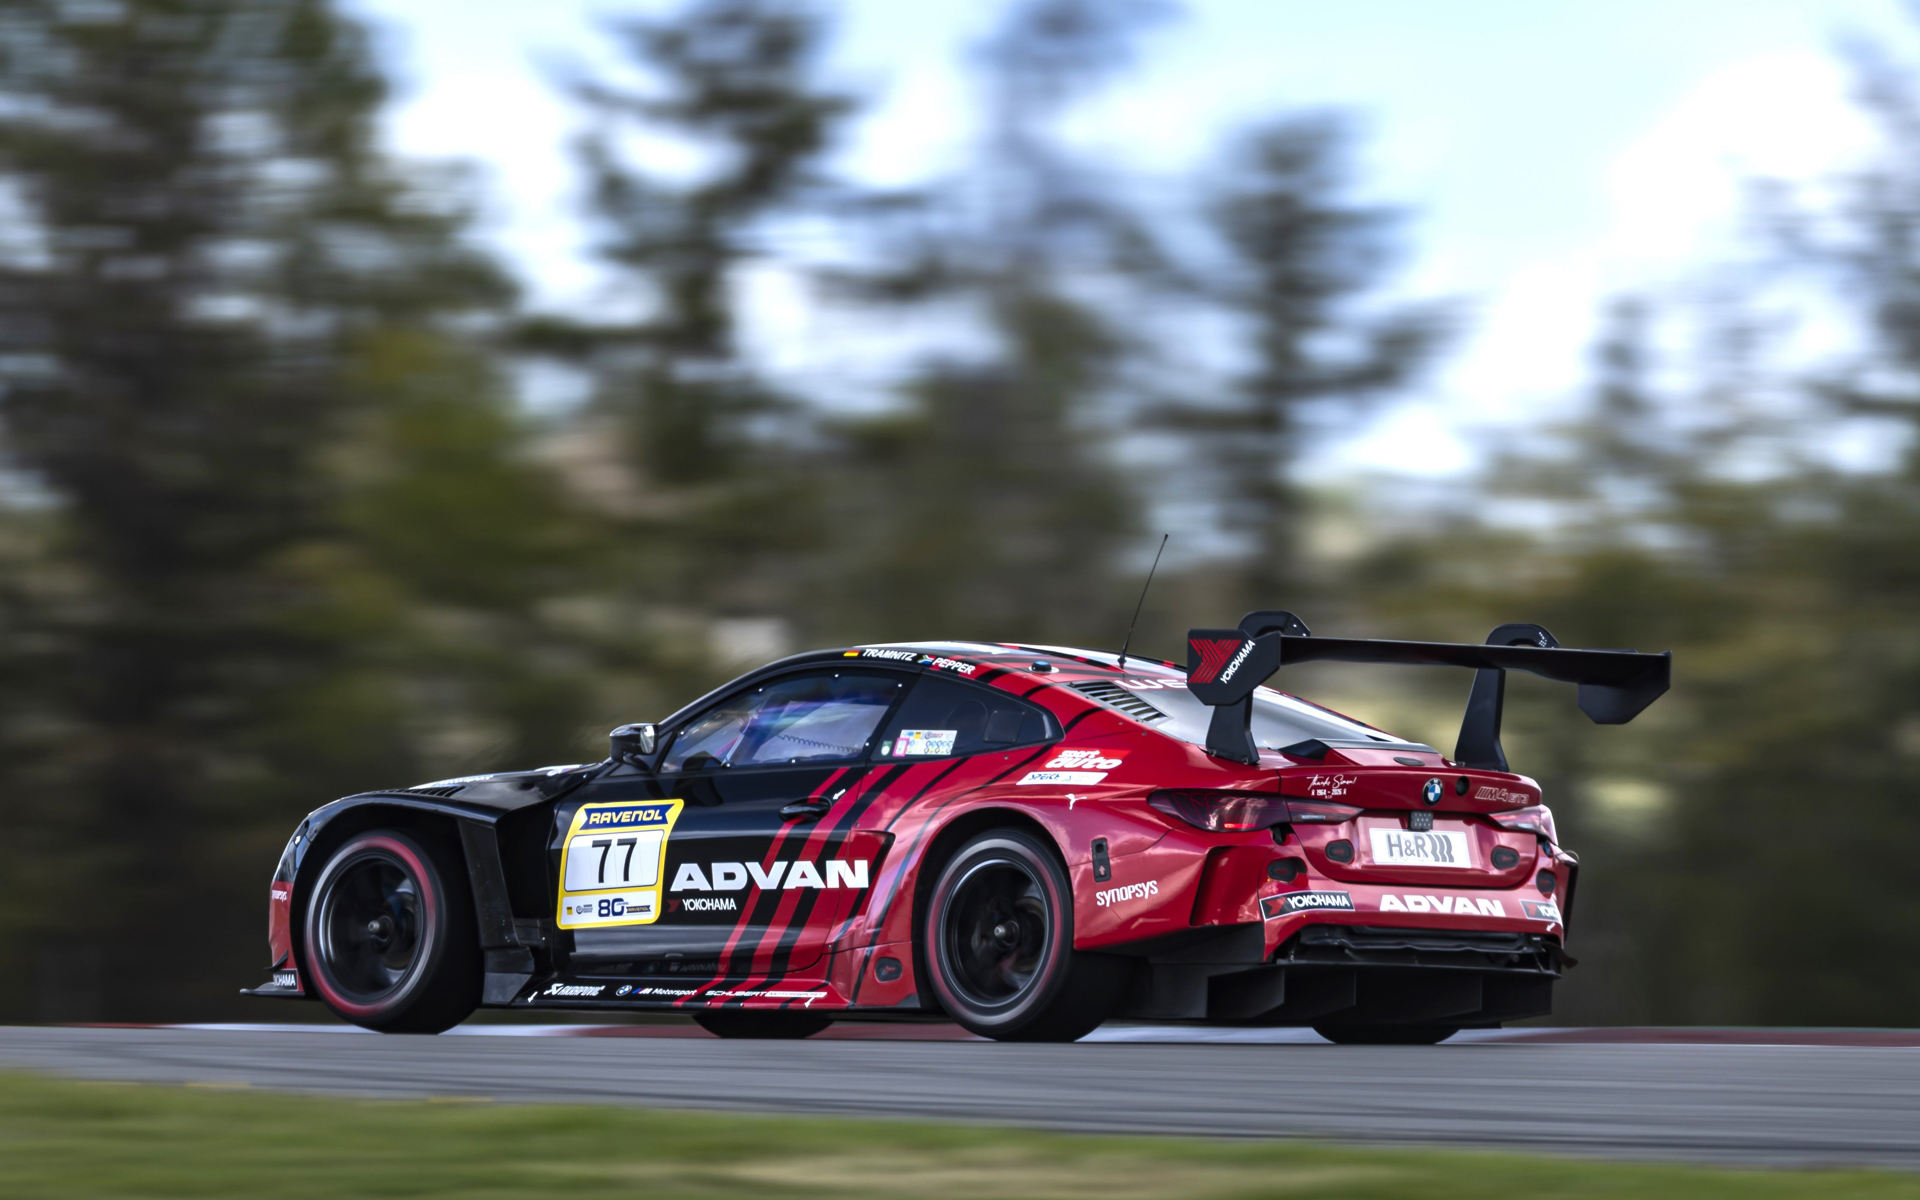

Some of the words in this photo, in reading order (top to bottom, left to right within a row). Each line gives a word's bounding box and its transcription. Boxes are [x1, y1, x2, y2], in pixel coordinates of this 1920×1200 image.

[862, 648, 918, 662] TRAMNITZ
[1219, 639, 1256, 684] YOKOHAMA
[931, 657, 976, 675] PEPPER
[1044, 756, 1123, 770] auto
[588, 807, 664, 825] RAVENOL
[1387, 833, 1429, 858] H&R
[591, 837, 638, 884] 77
[669, 859, 870, 892] ADVAN
[1095, 879, 1159, 908] SYNOPSYS
[1286, 891, 1351, 909] YOKOHAMA
[598, 897, 625, 918] 80
[682, 897, 737, 912] YOKOHAMA
[1379, 893, 1506, 917] ADVAN
[652, 987, 698, 996] Motorsport
